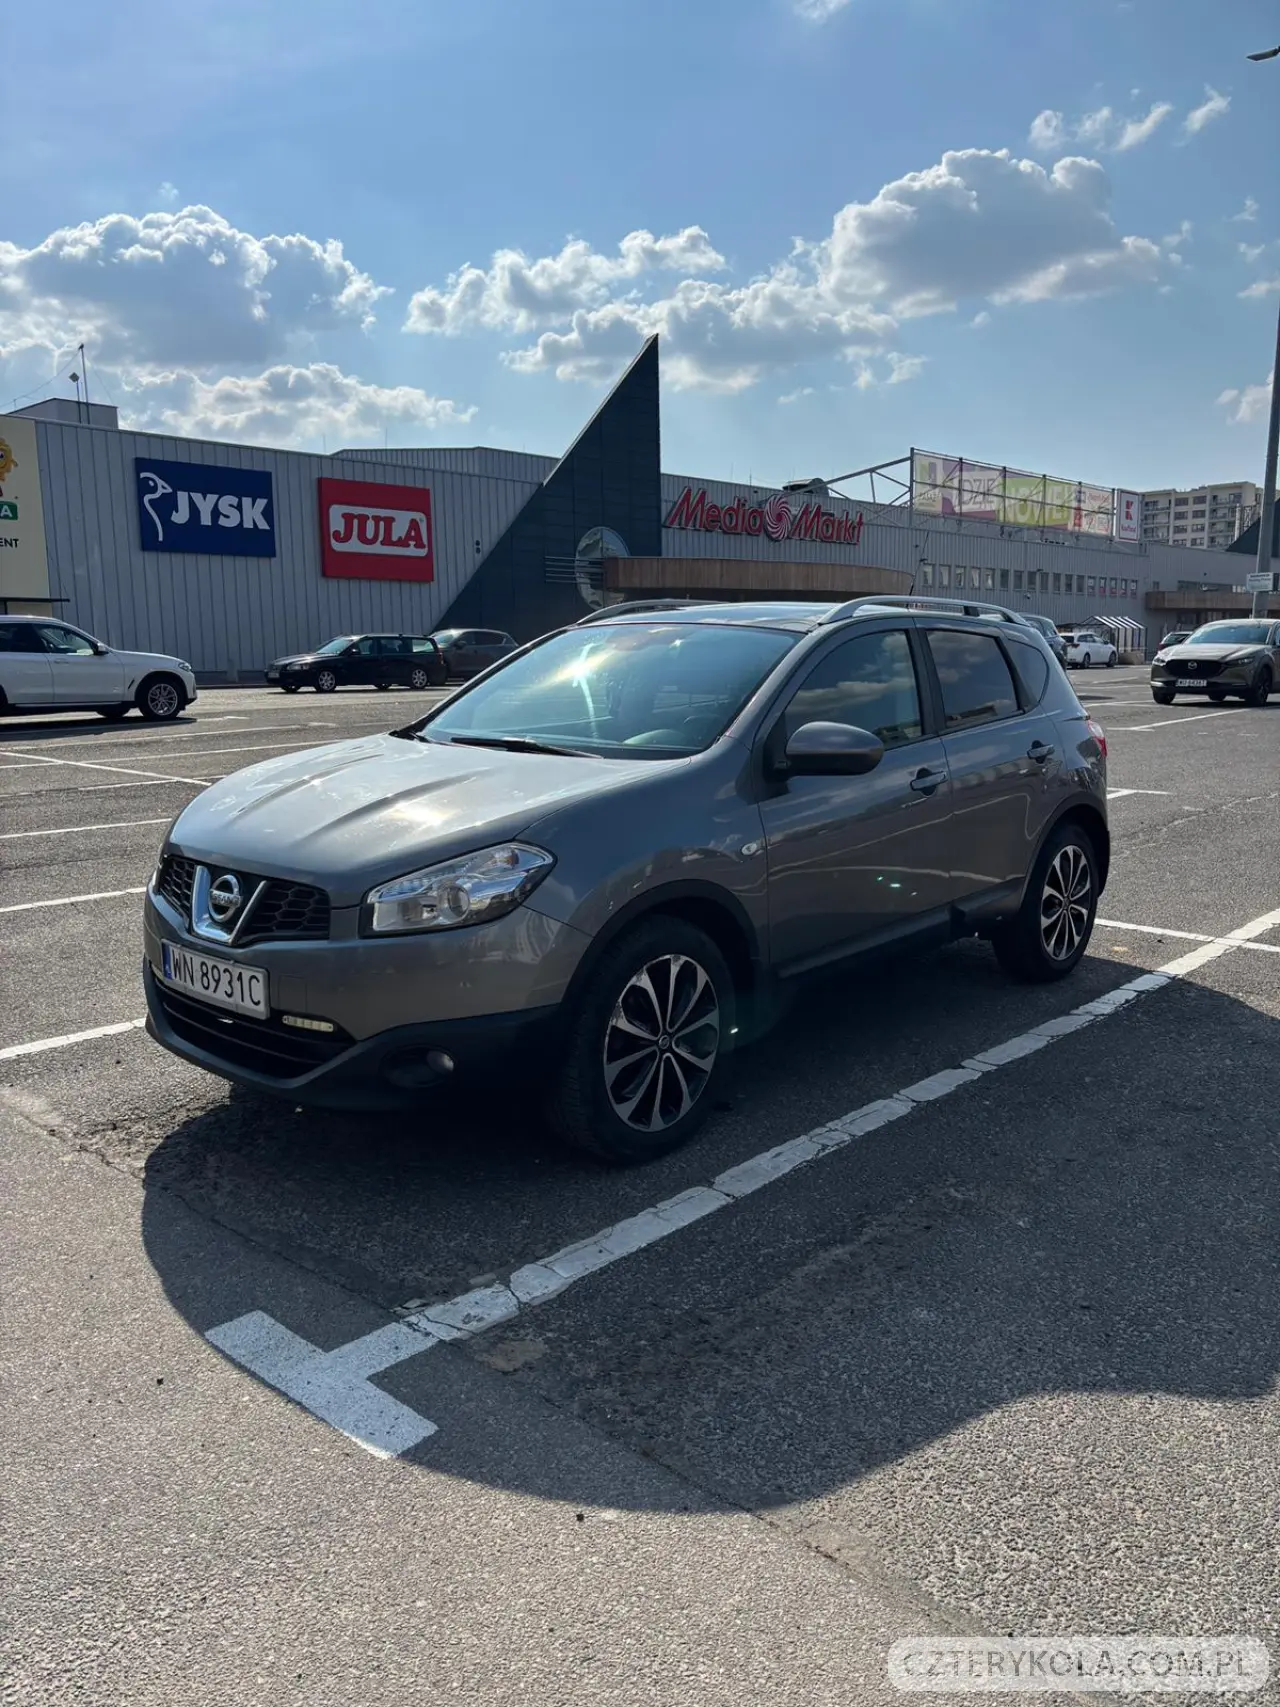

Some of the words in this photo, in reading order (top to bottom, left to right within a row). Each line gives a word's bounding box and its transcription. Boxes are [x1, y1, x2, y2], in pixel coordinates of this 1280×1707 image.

[170, 490, 270, 530] JYSK
[332, 512, 427, 550] JULA
[666, 487, 764, 535] Media
[790, 503, 864, 545] Markt
[172, 949, 194, 986] WN
[200, 960, 261, 1007] 8931C
